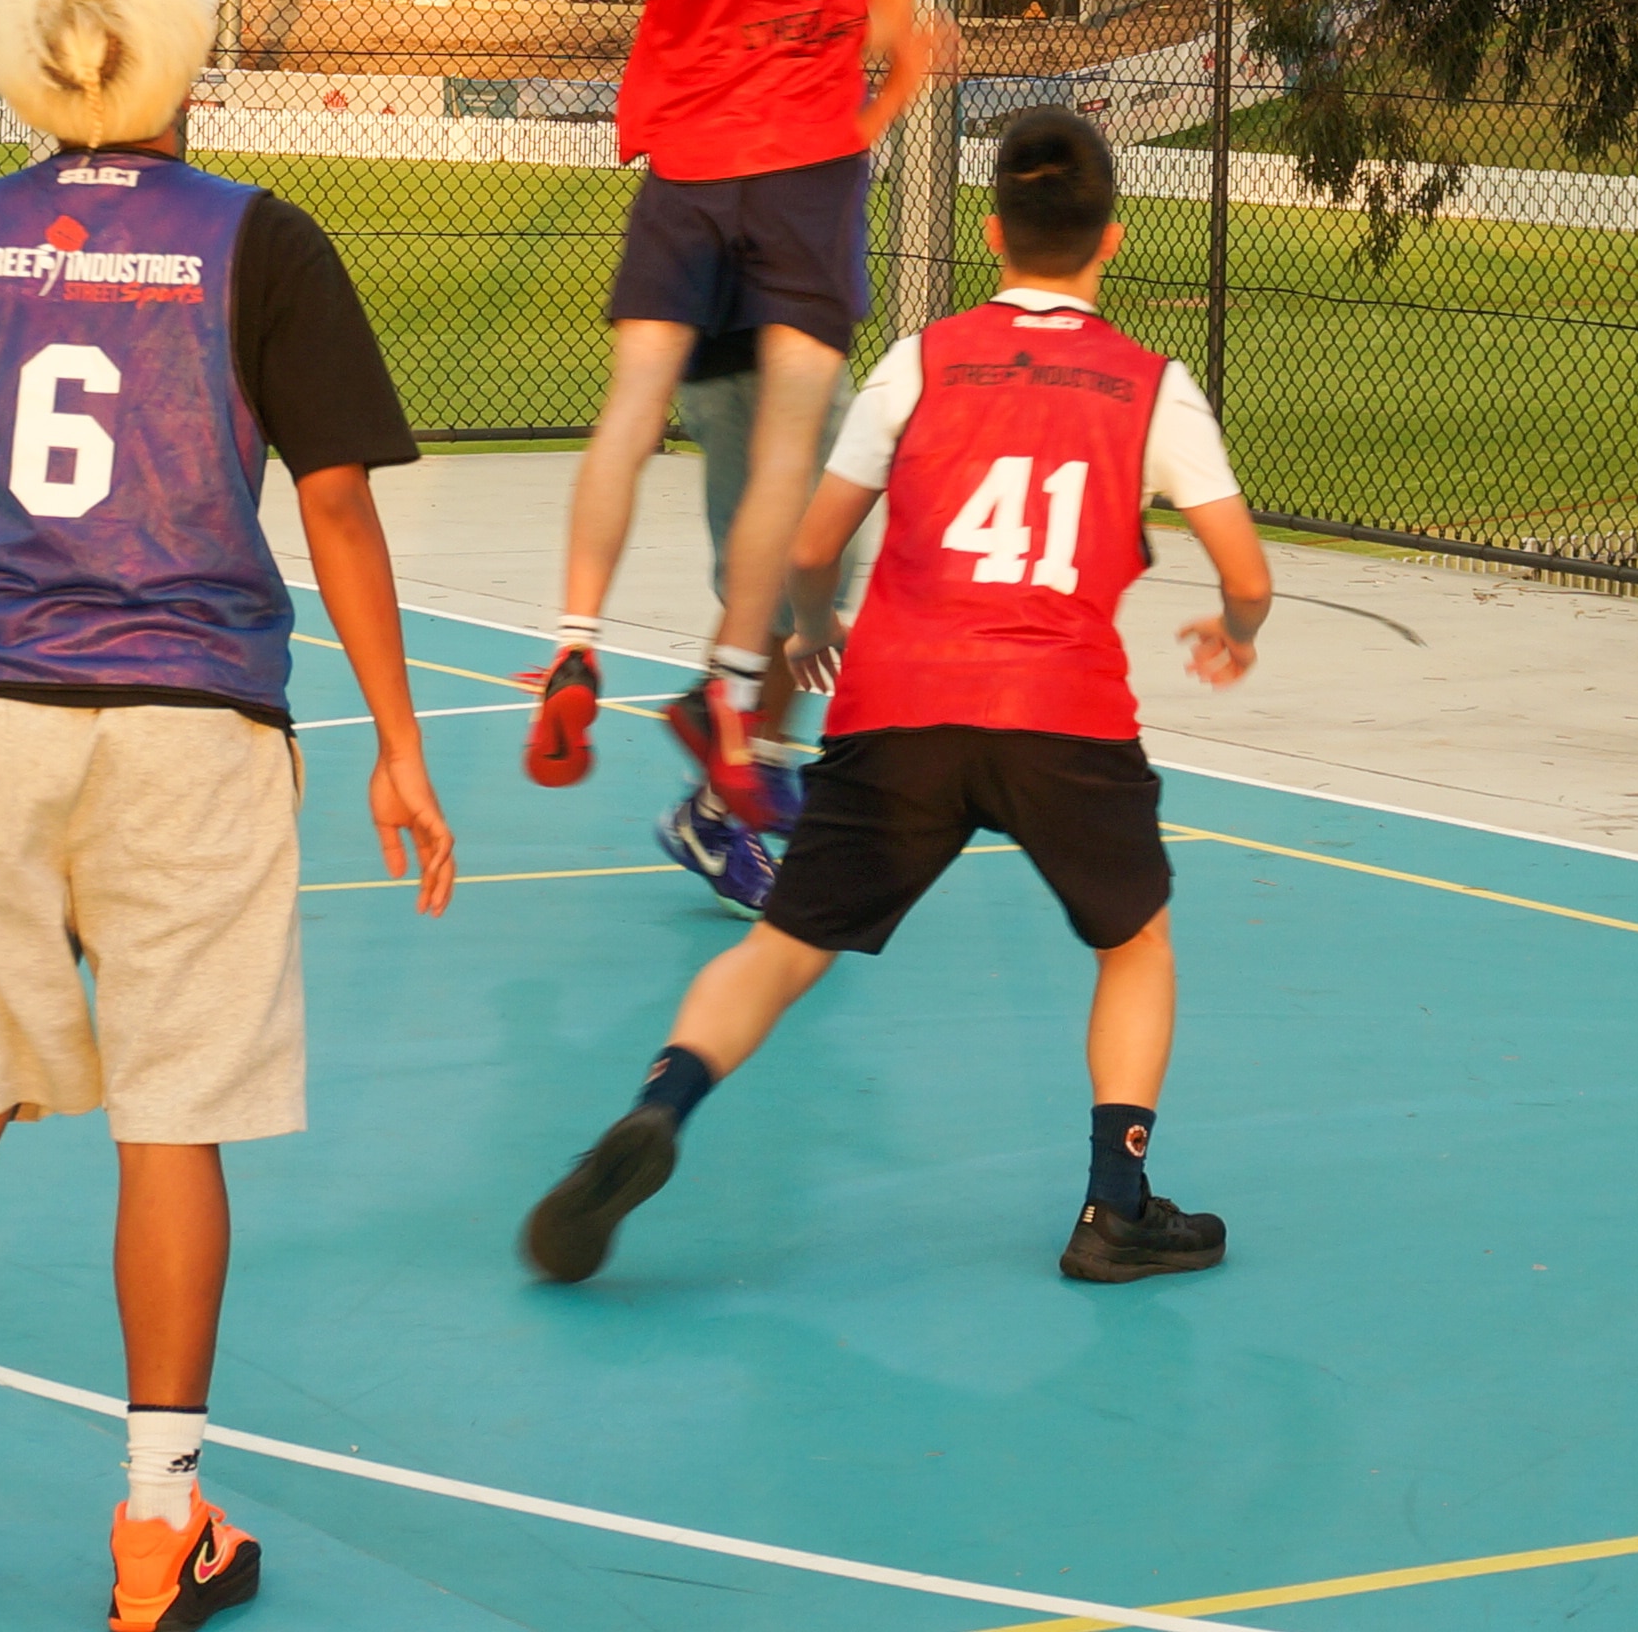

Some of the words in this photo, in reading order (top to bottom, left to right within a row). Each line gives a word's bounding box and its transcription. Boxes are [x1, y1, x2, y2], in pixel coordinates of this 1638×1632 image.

[57, 166, 141, 187] SELECT
[64, 251, 203, 285] INDUSTRIES
[9, 343, 121, 518] 6
[941, 456, 1089, 596] 41
